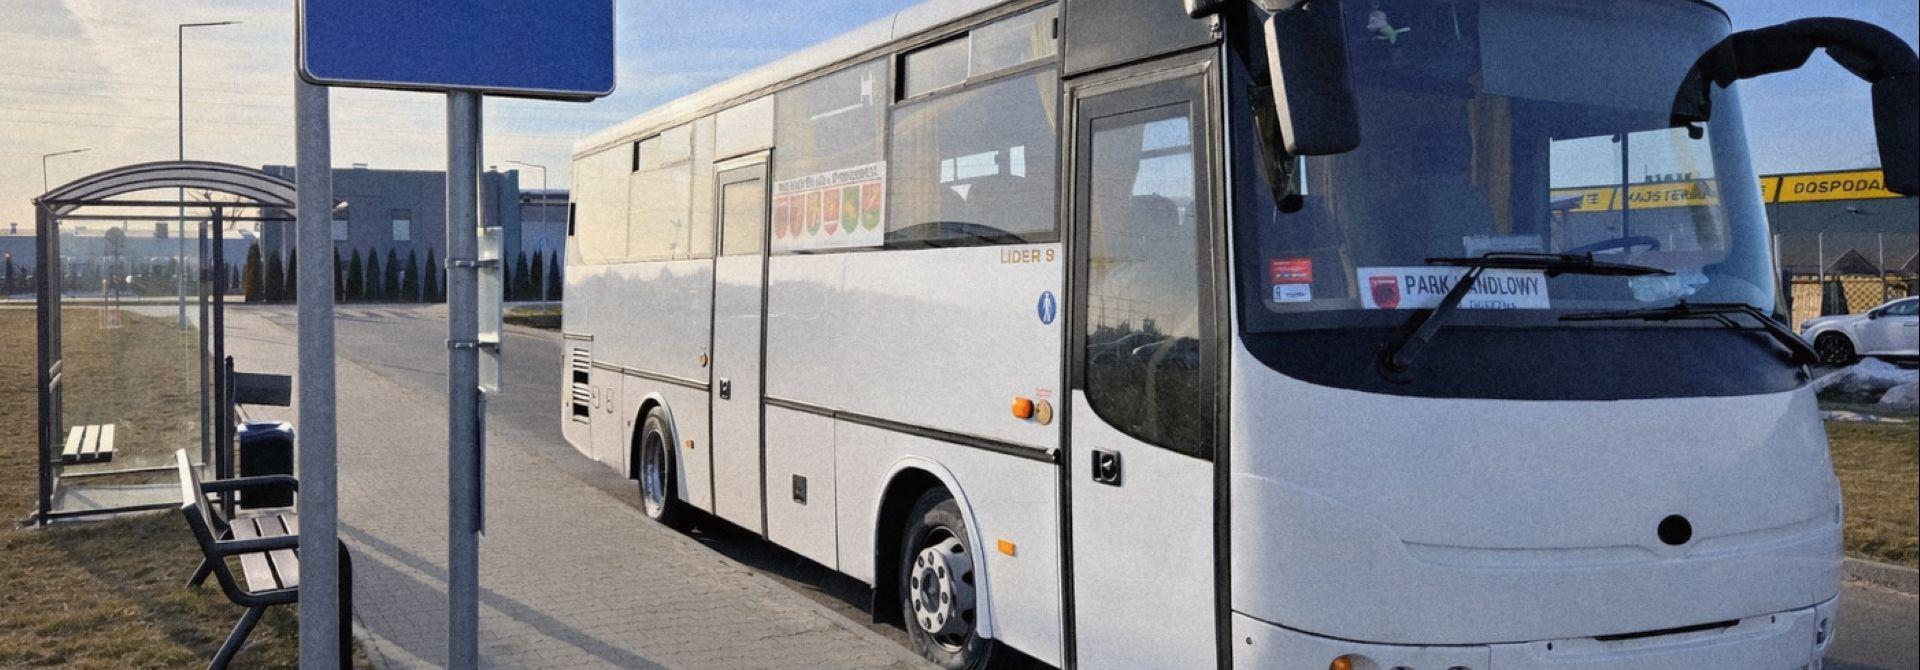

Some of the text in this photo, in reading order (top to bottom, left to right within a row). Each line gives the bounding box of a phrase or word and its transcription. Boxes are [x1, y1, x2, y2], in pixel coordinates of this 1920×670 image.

[1001, 248, 1040, 263] LIDER
[1405, 275, 1538, 296] PARK ANDLOWY
